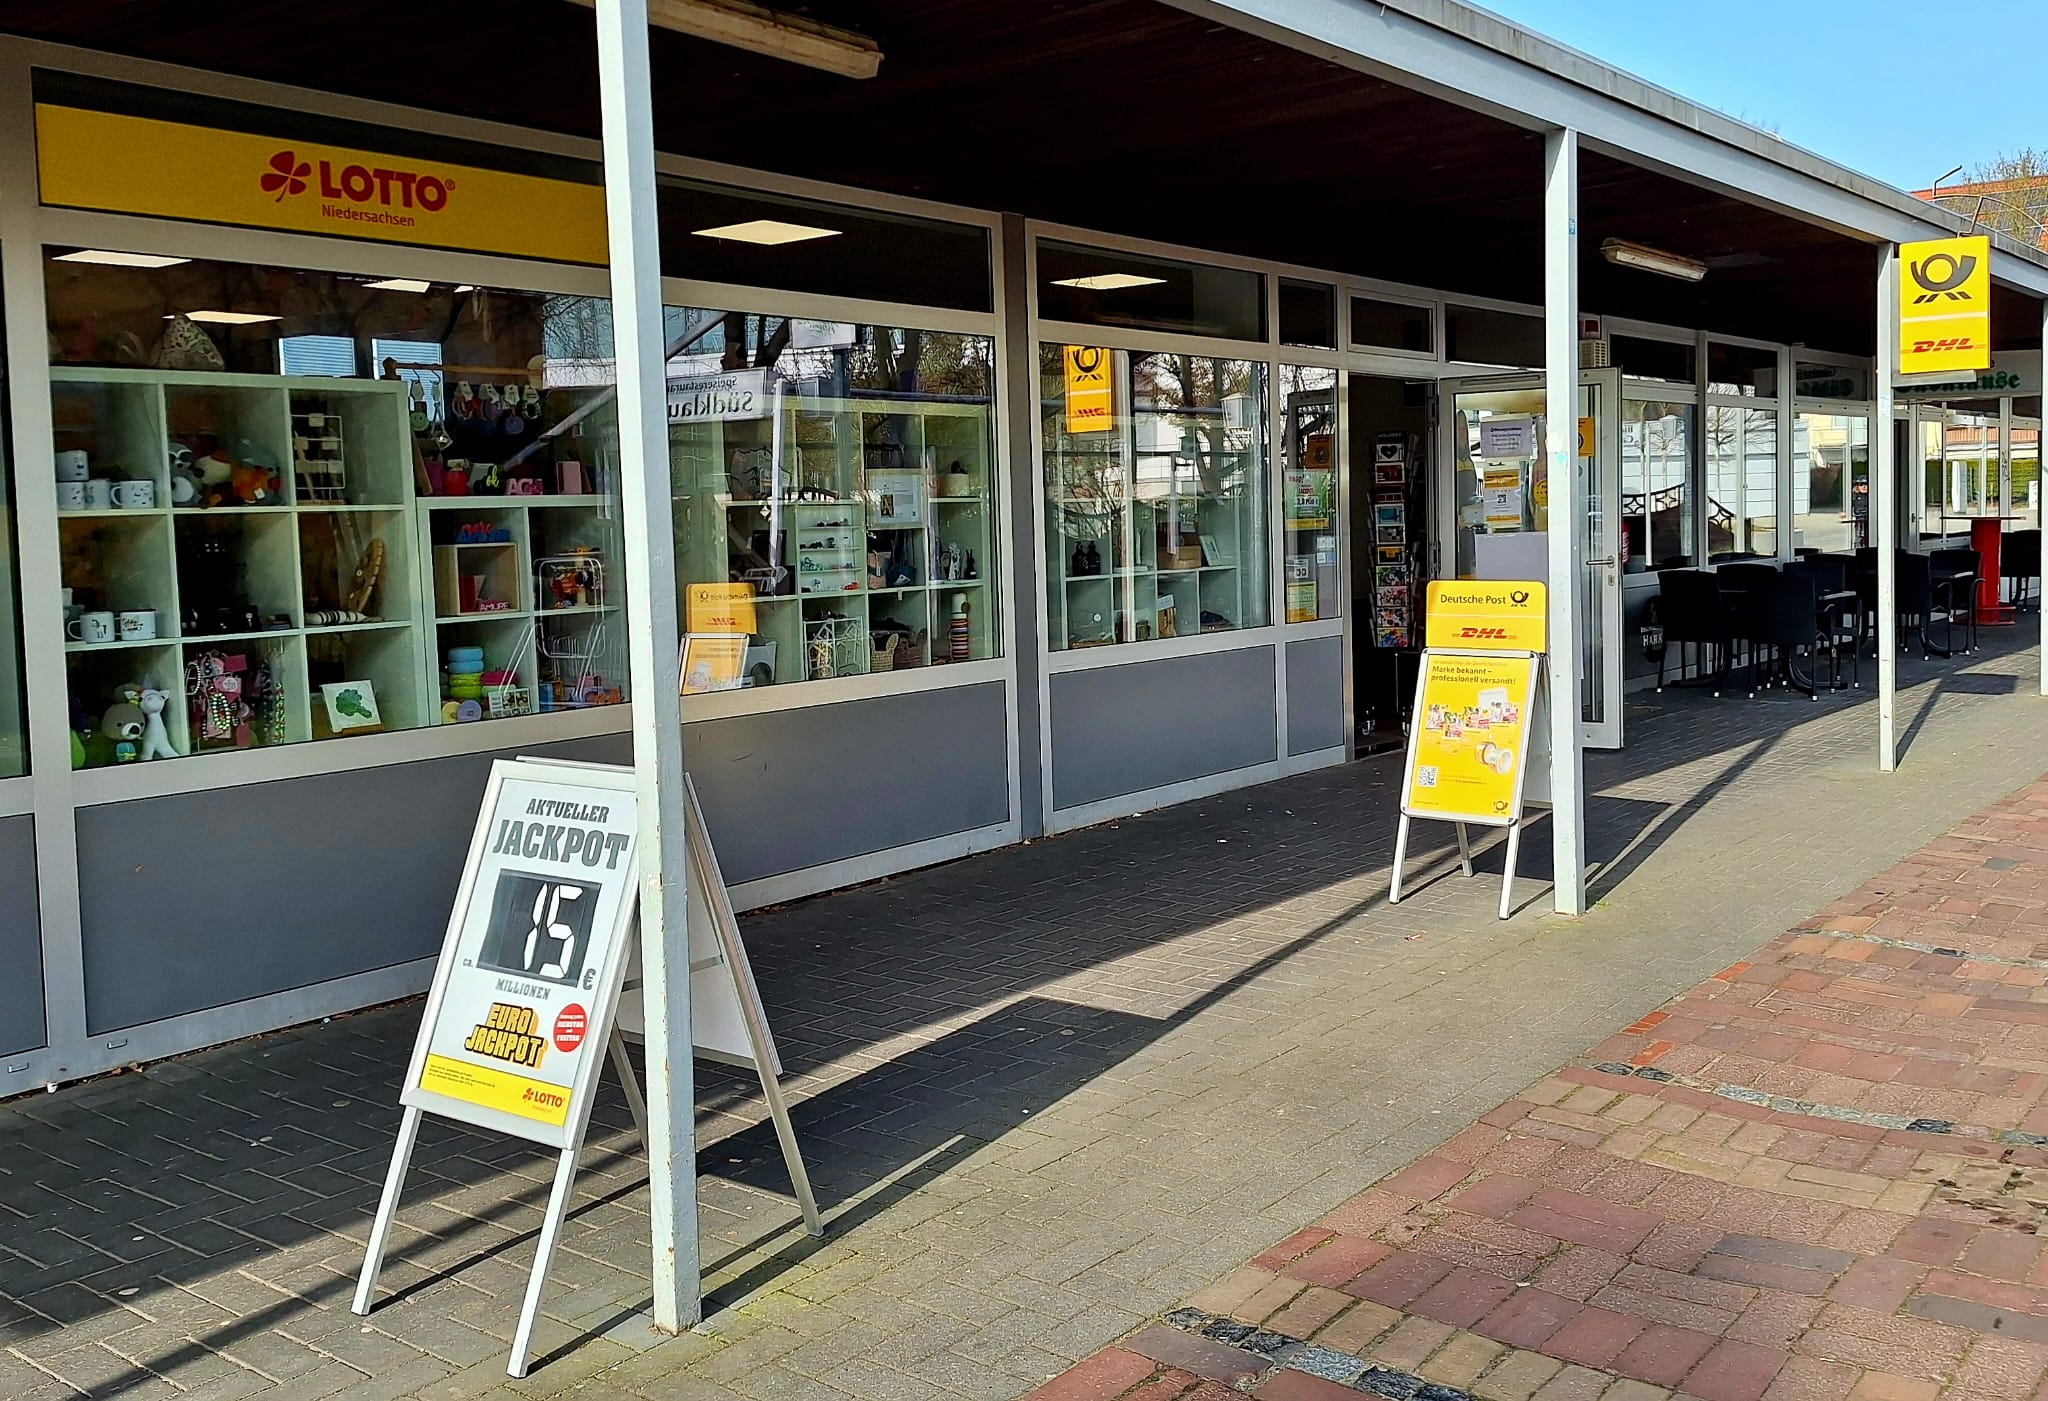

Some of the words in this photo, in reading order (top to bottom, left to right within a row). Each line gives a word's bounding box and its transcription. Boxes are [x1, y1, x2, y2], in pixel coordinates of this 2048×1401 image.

[321, 203, 415, 227] Niedersachsen
[1911, 337, 1974, 354] DHL
[1440, 594, 1484, 604] Deutsche
[1485, 595, 1506, 605] Post
[1461, 627, 1507, 639] DHL
[1431, 675, 1479, 684] professionell
[1480, 677, 1516, 685] versandt!
[1456, 666, 1486, 675] bekannt
[526, 798, 610, 824] AKTUELLER
[492, 819, 630, 870] JACKPOT
[523, 882, 584, 979] 15
[463, 958, 474, 968] ca.
[495, 978, 551, 1000] MILLIONEN
[582, 968, 596, 991] €
[485, 1003, 539, 1036] EURO
[464, 1025, 549, 1069] JACKPOT
[534, 1090, 563, 1108] LOTTO
